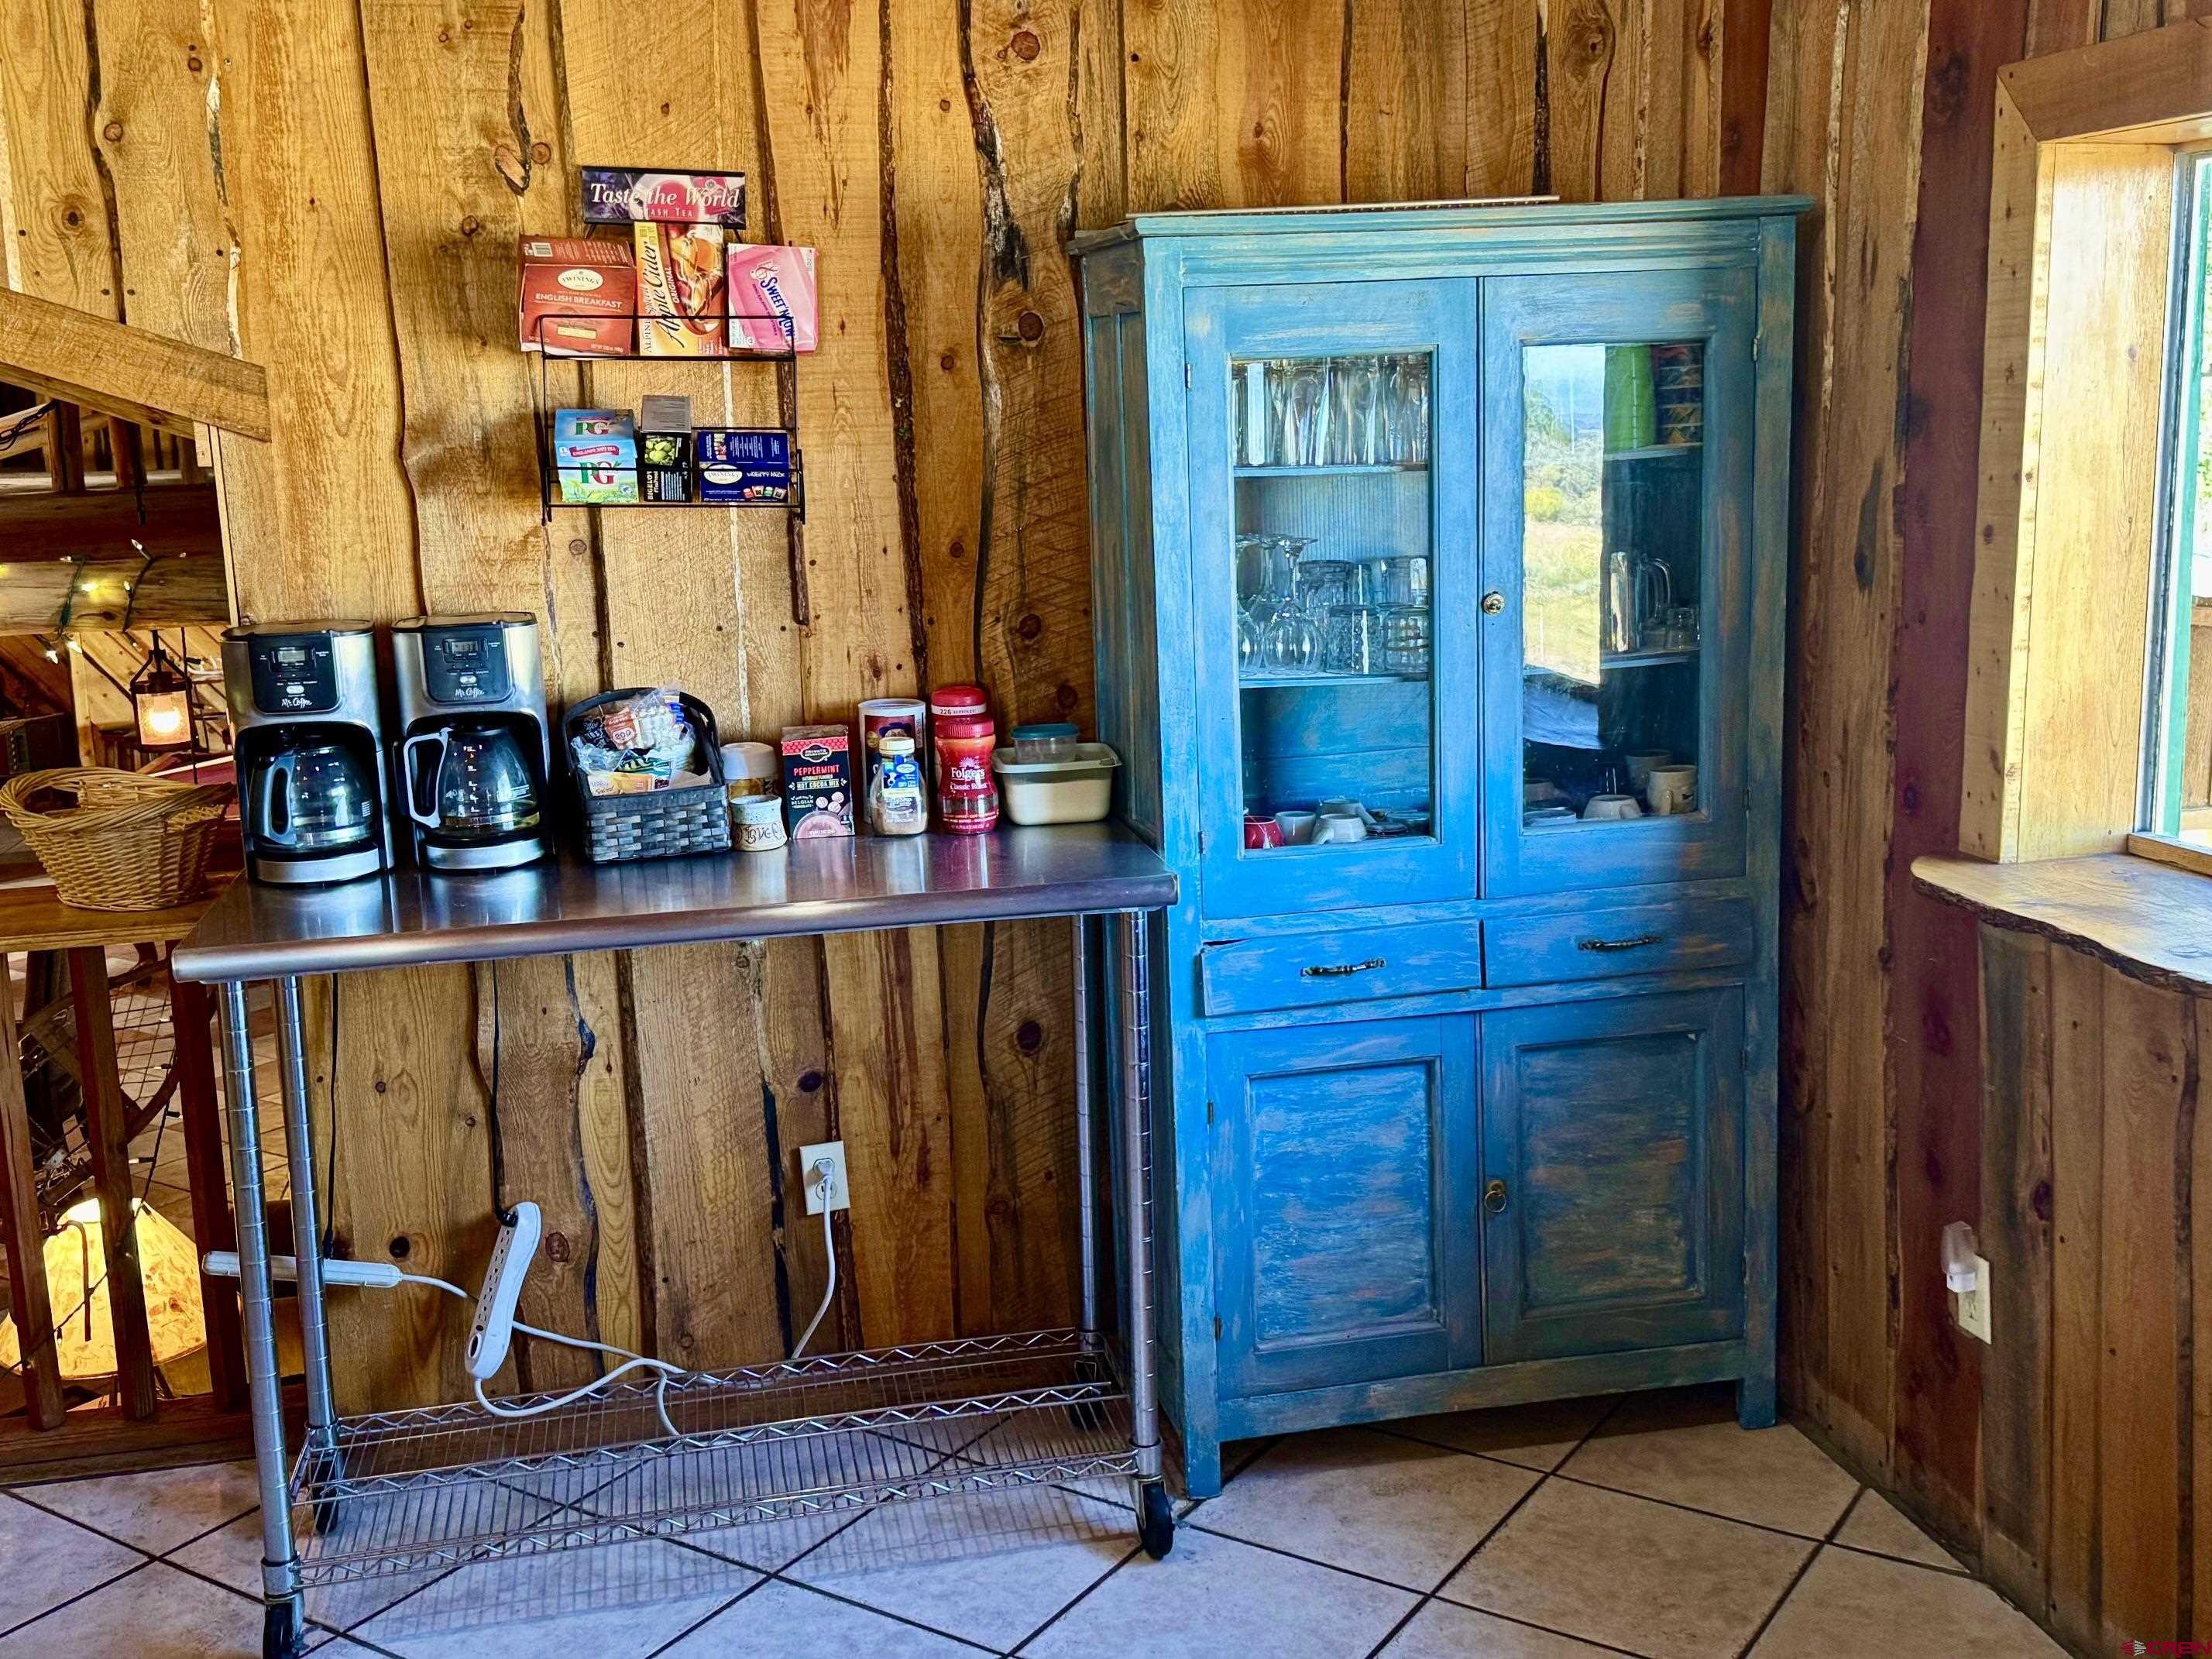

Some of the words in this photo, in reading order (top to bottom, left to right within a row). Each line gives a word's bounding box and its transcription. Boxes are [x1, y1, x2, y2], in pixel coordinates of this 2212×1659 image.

[590, 183, 641, 204] Taste
[648, 186, 677, 206] the
[686, 187, 740, 208] World
[641, 242, 663, 288] Cider
[665, 267, 680, 304] ORIGINAL
[535, 293, 572, 303] ENGLISH
[573, 296, 623, 309] BREAKFAST
[653, 288, 685, 349] Apple
[575, 421, 610, 434] PG
[580, 461, 615, 484] PG
[465, 687, 485, 699] Coffee
[292, 697, 313, 708] Coffee
[793, 764, 840, 777] PEPPERMINT
[951, 767, 985, 781] Folgers
